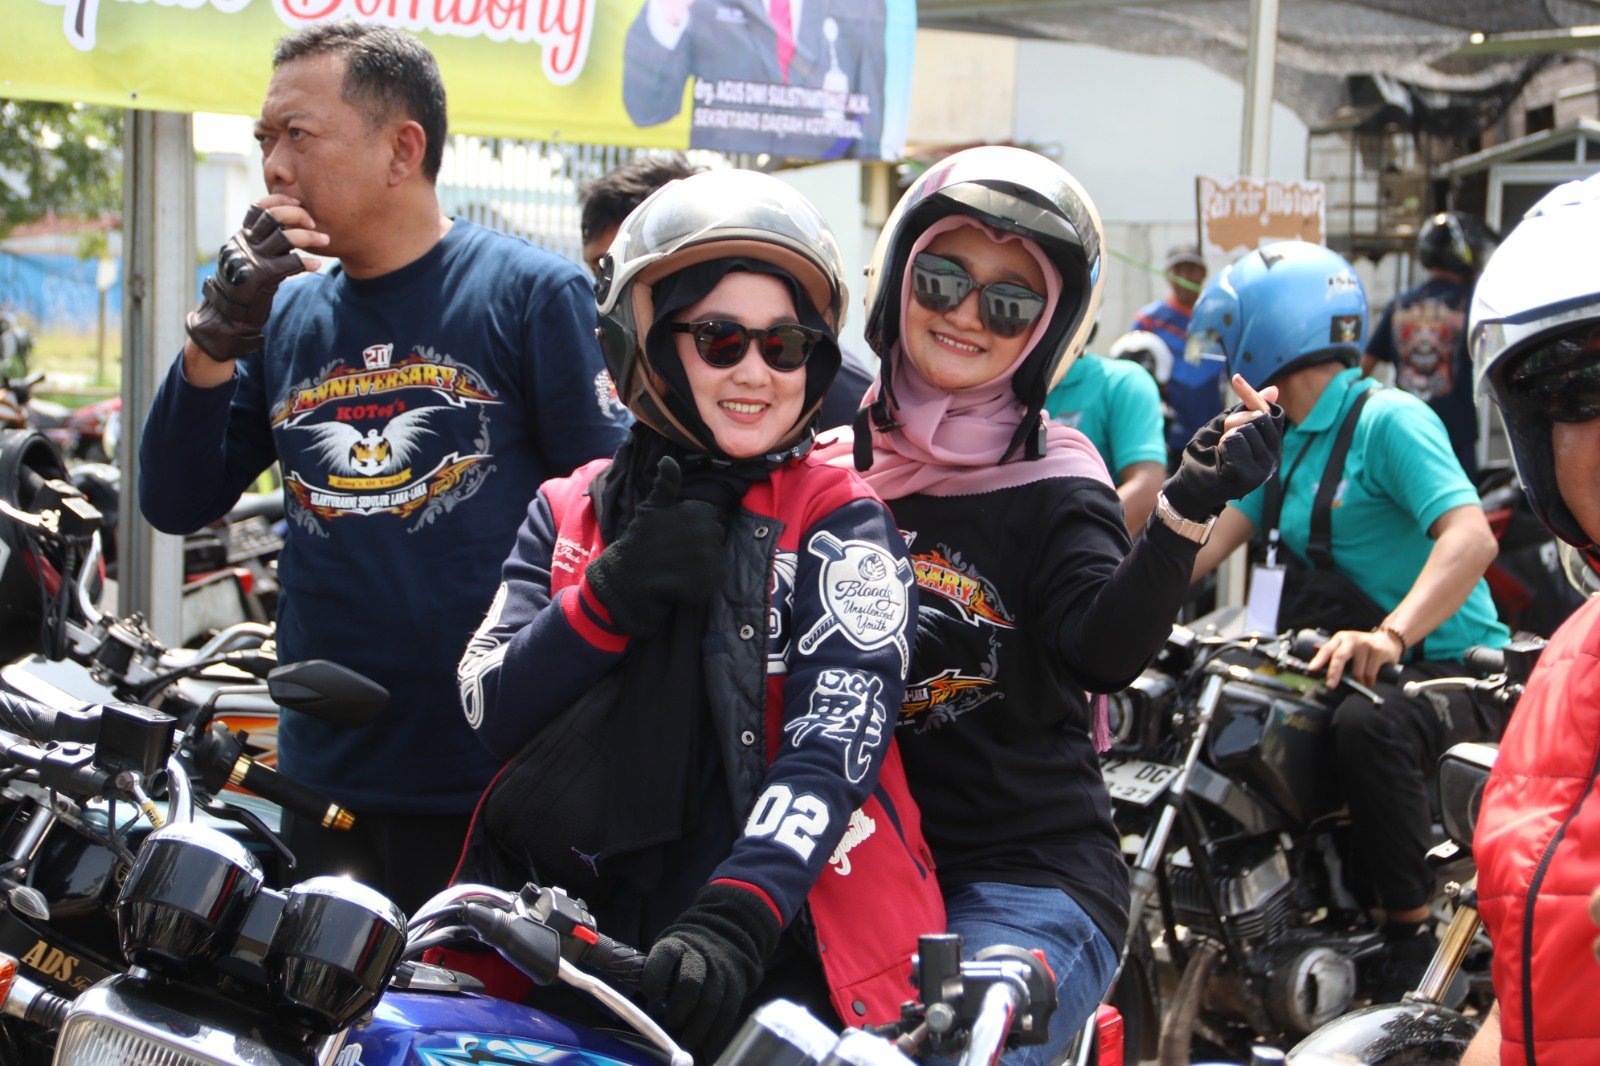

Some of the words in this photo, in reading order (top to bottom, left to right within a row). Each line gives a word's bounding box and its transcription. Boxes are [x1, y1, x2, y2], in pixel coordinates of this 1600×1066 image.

[293, 364, 457, 413] ANNIVERSARY
[912, 560, 979, 607] SARY
[856, 614, 888, 636] Youth
[744, 782, 830, 864] 02
[20, 939, 80, 982] ADS
